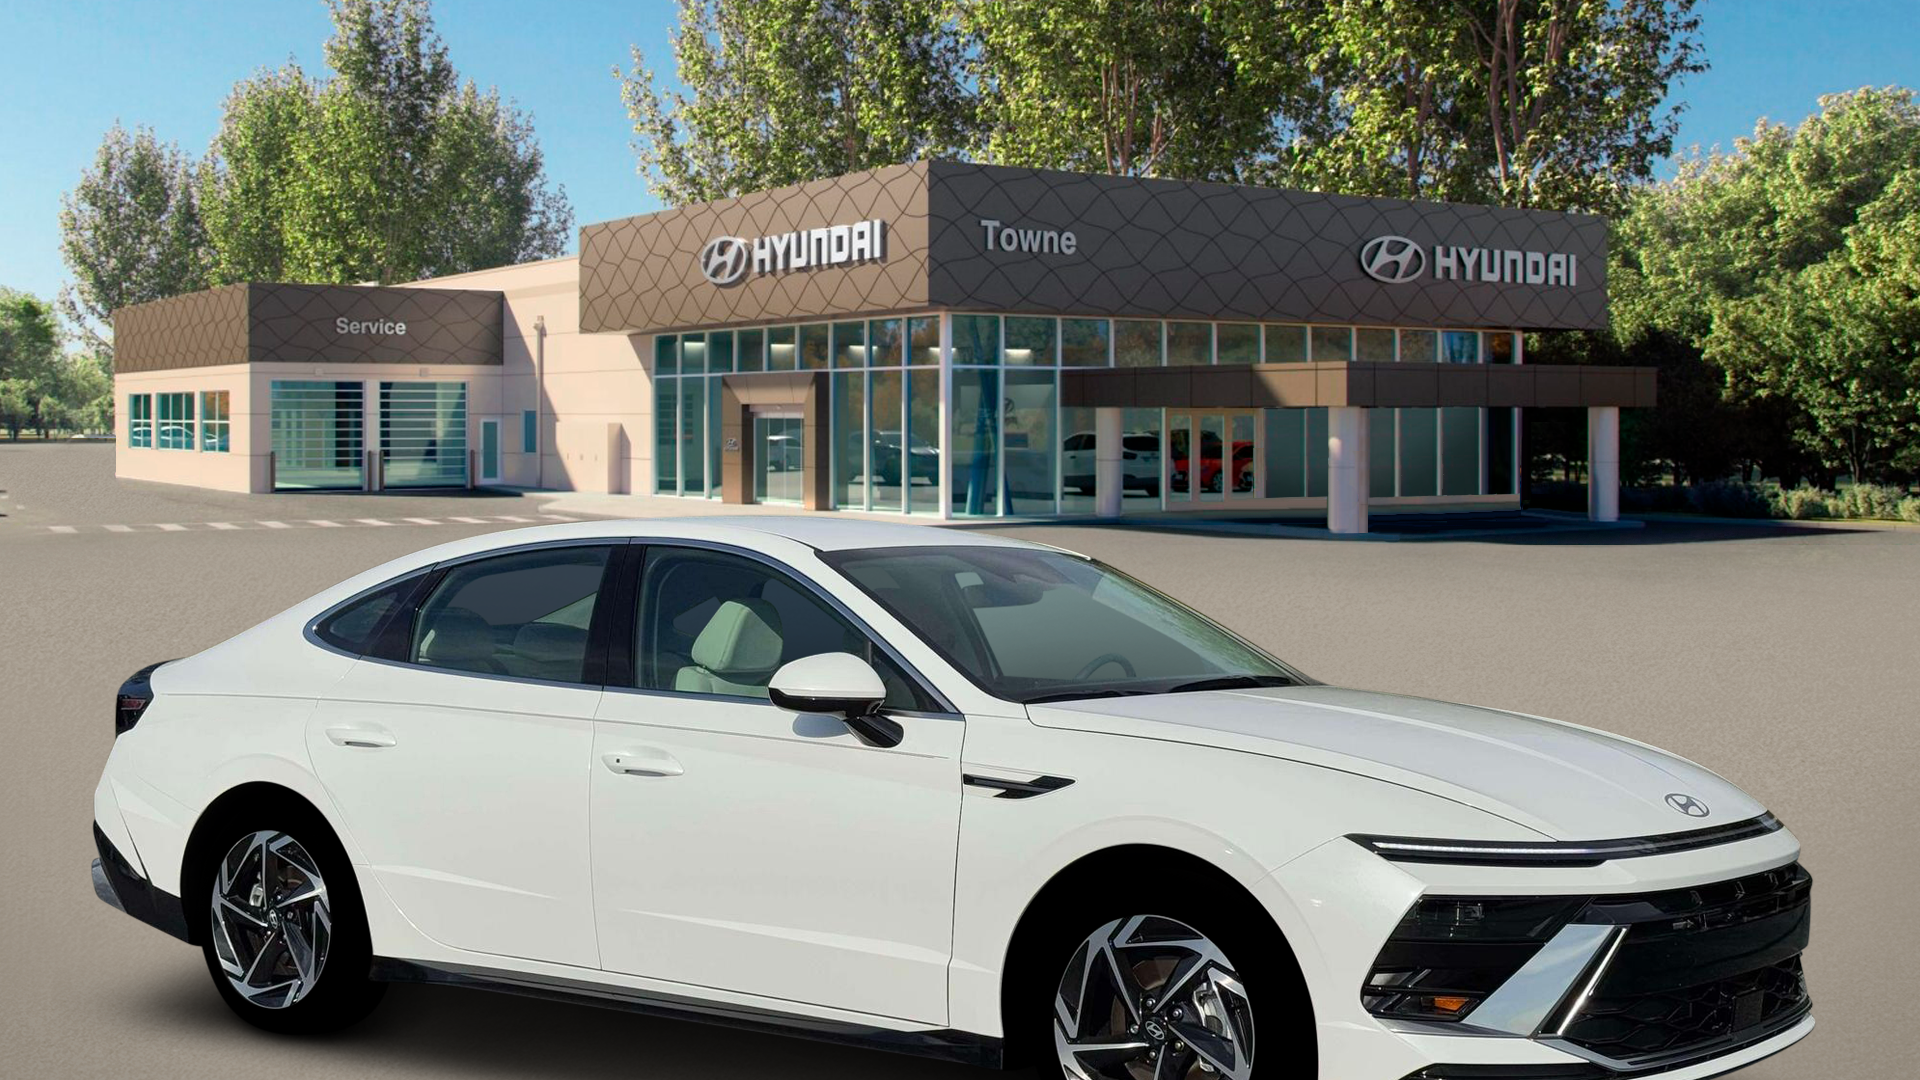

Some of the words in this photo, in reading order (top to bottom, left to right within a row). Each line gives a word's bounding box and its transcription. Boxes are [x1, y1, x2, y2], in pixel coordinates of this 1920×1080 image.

[753, 219, 881, 273] HYUNDAI
[980, 219, 1077, 255] Towne
[1434, 245, 1576, 286] HYUNDAI
[335, 317, 406, 335] Service
